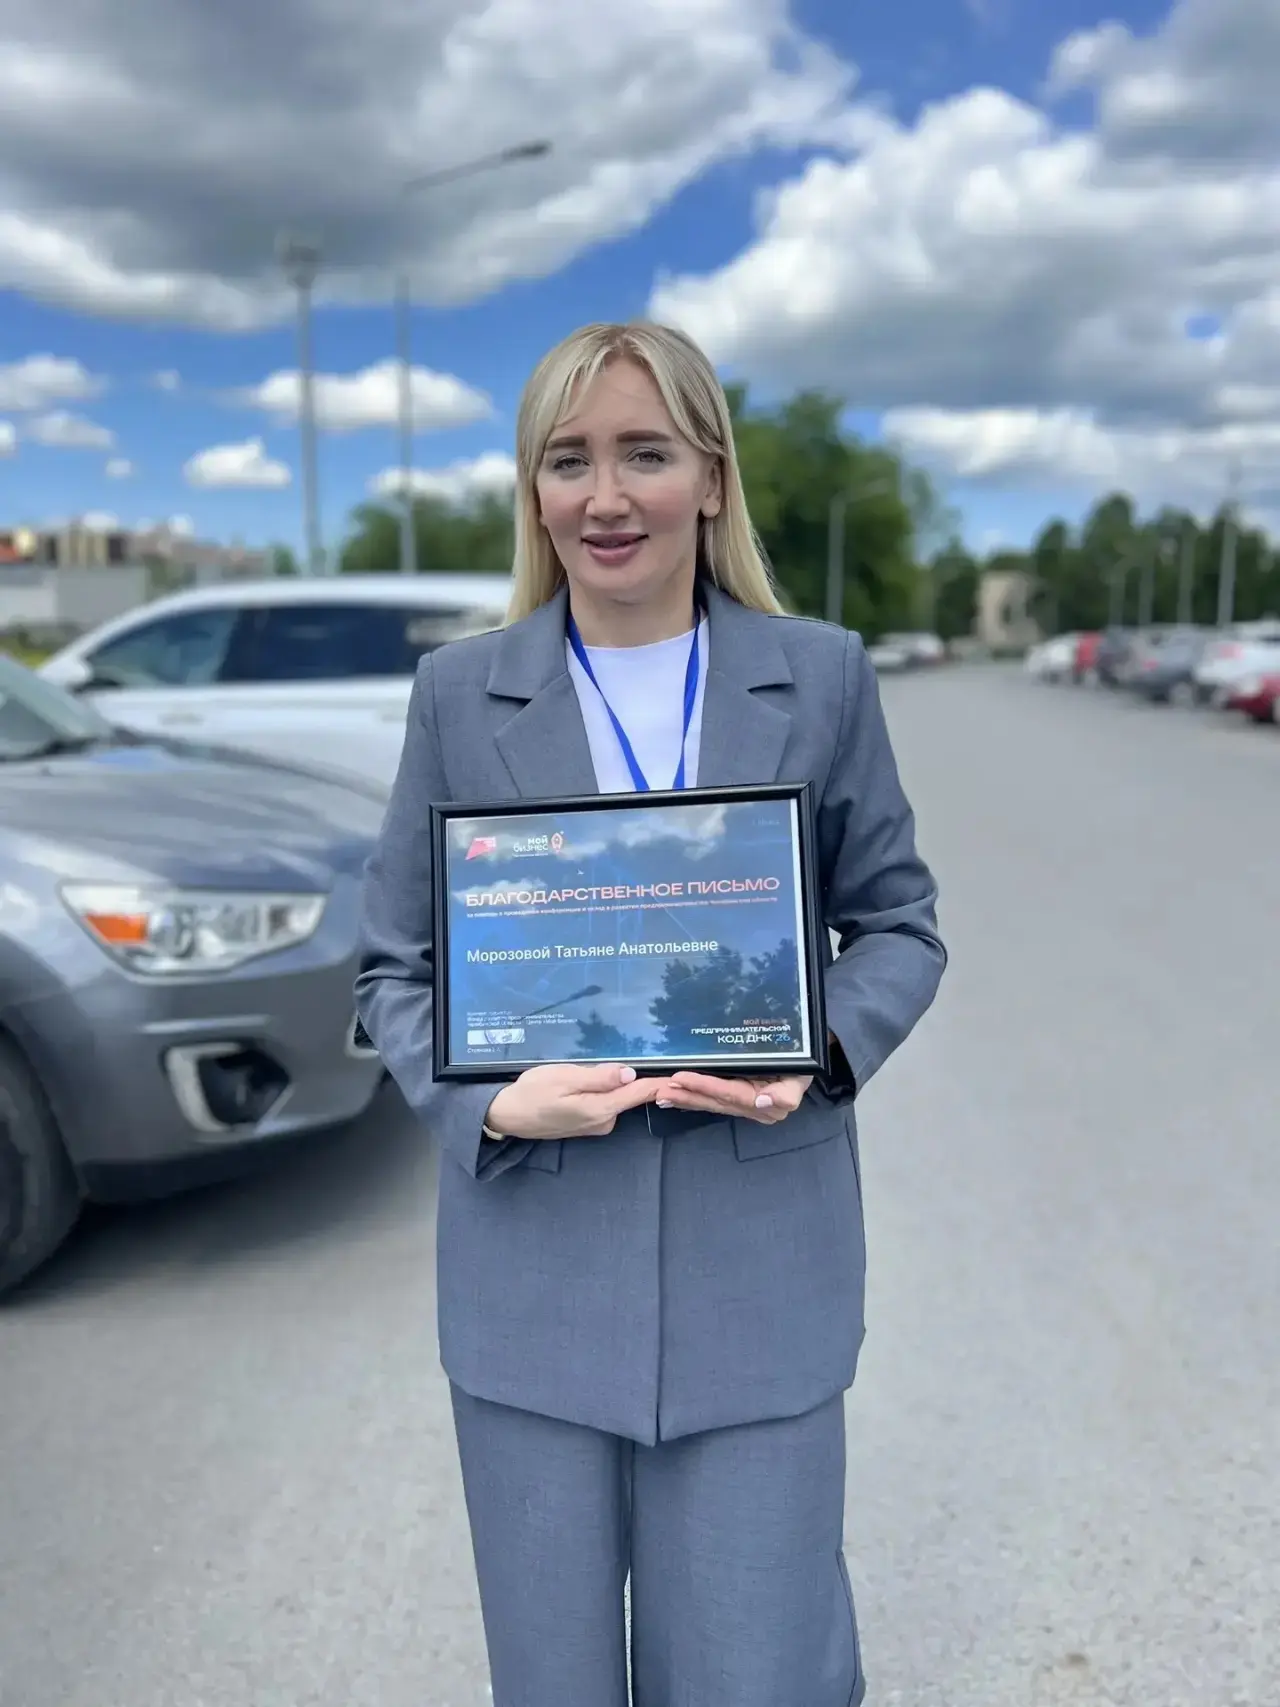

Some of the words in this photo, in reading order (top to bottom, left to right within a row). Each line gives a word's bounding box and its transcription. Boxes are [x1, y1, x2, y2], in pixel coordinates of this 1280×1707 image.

[465, 882, 684, 907] БЛАГОДАРСТВЕННОЕ
[687, 877, 780, 895] ПИСЬМО
[467, 946, 551, 964] Морозовой
[554, 944, 615, 959] Татьяне
[618, 940, 719, 956] Анатольевне
[690, 1024, 791, 1035] ПРЕДПРИНИМАТЕЛЬСКИЙ
[717, 1035, 745, 1044] КОД
